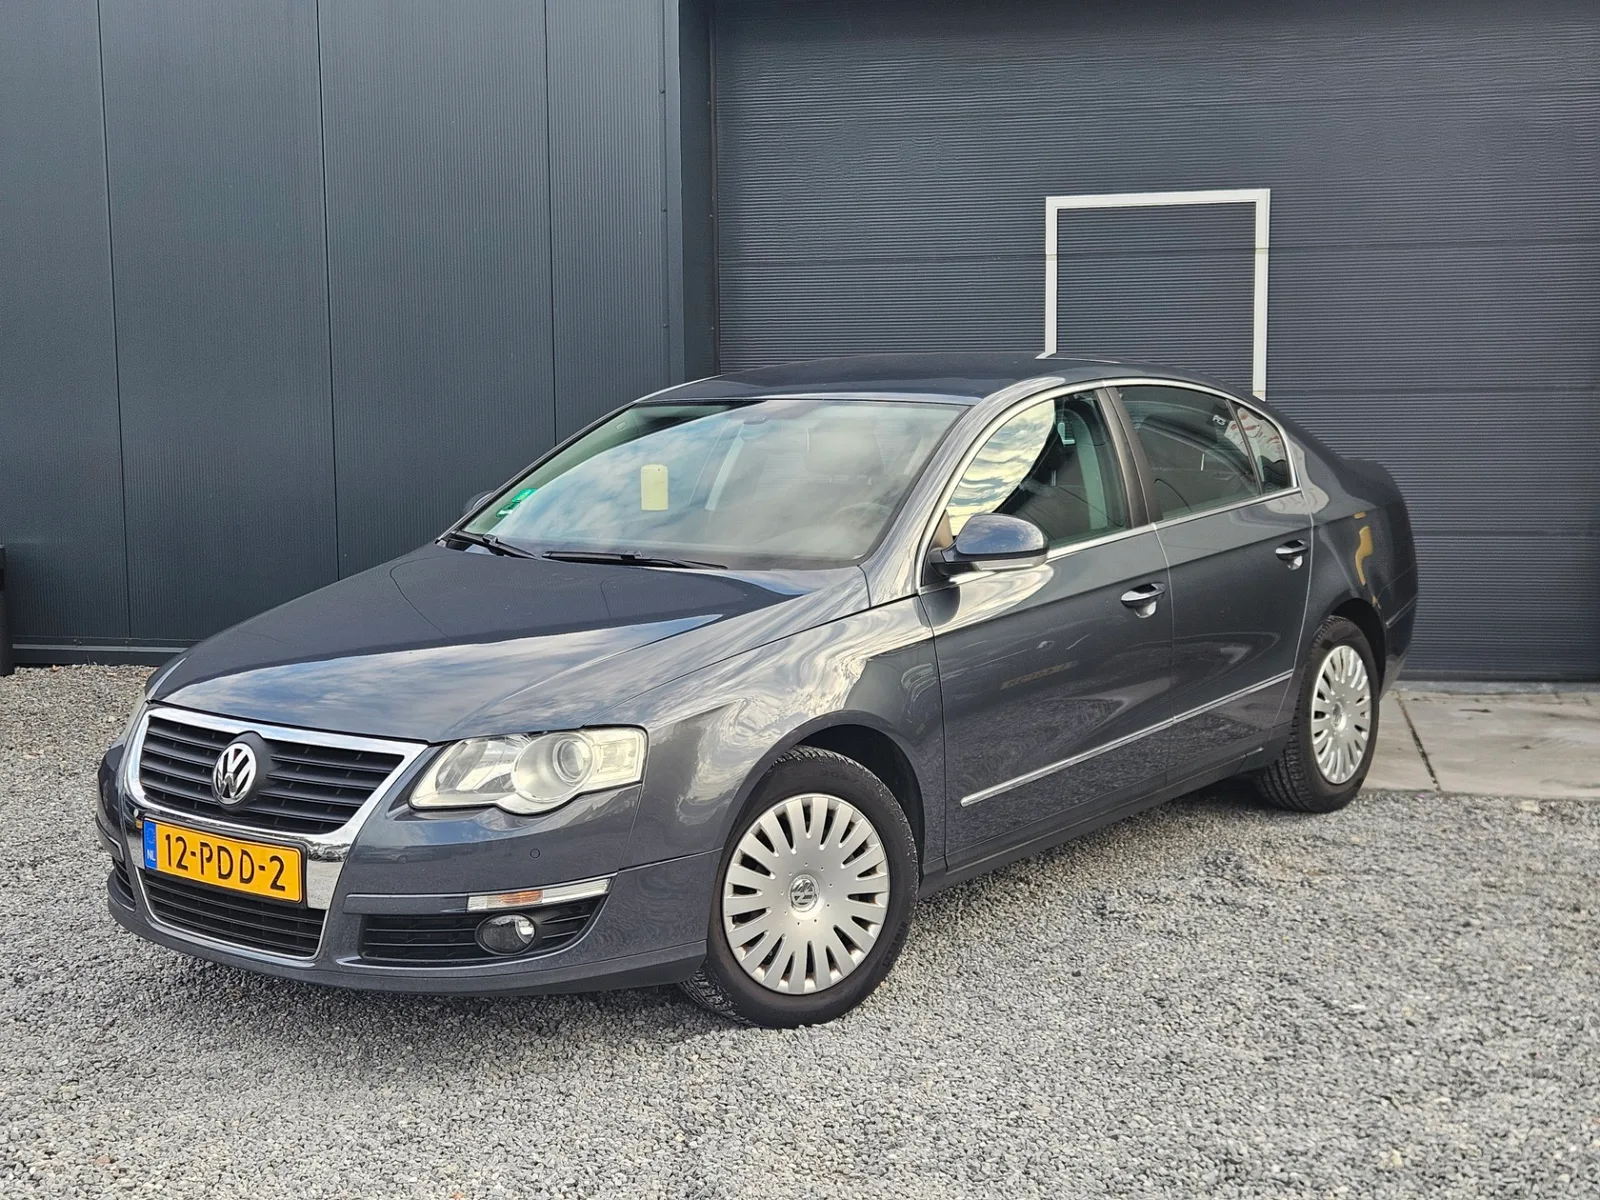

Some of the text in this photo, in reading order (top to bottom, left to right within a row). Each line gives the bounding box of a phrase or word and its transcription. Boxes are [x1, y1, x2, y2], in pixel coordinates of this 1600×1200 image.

[213, 743, 256, 804] VW
[146, 849, 156, 862] NL
[165, 833, 286, 892] 12-PDD-2
